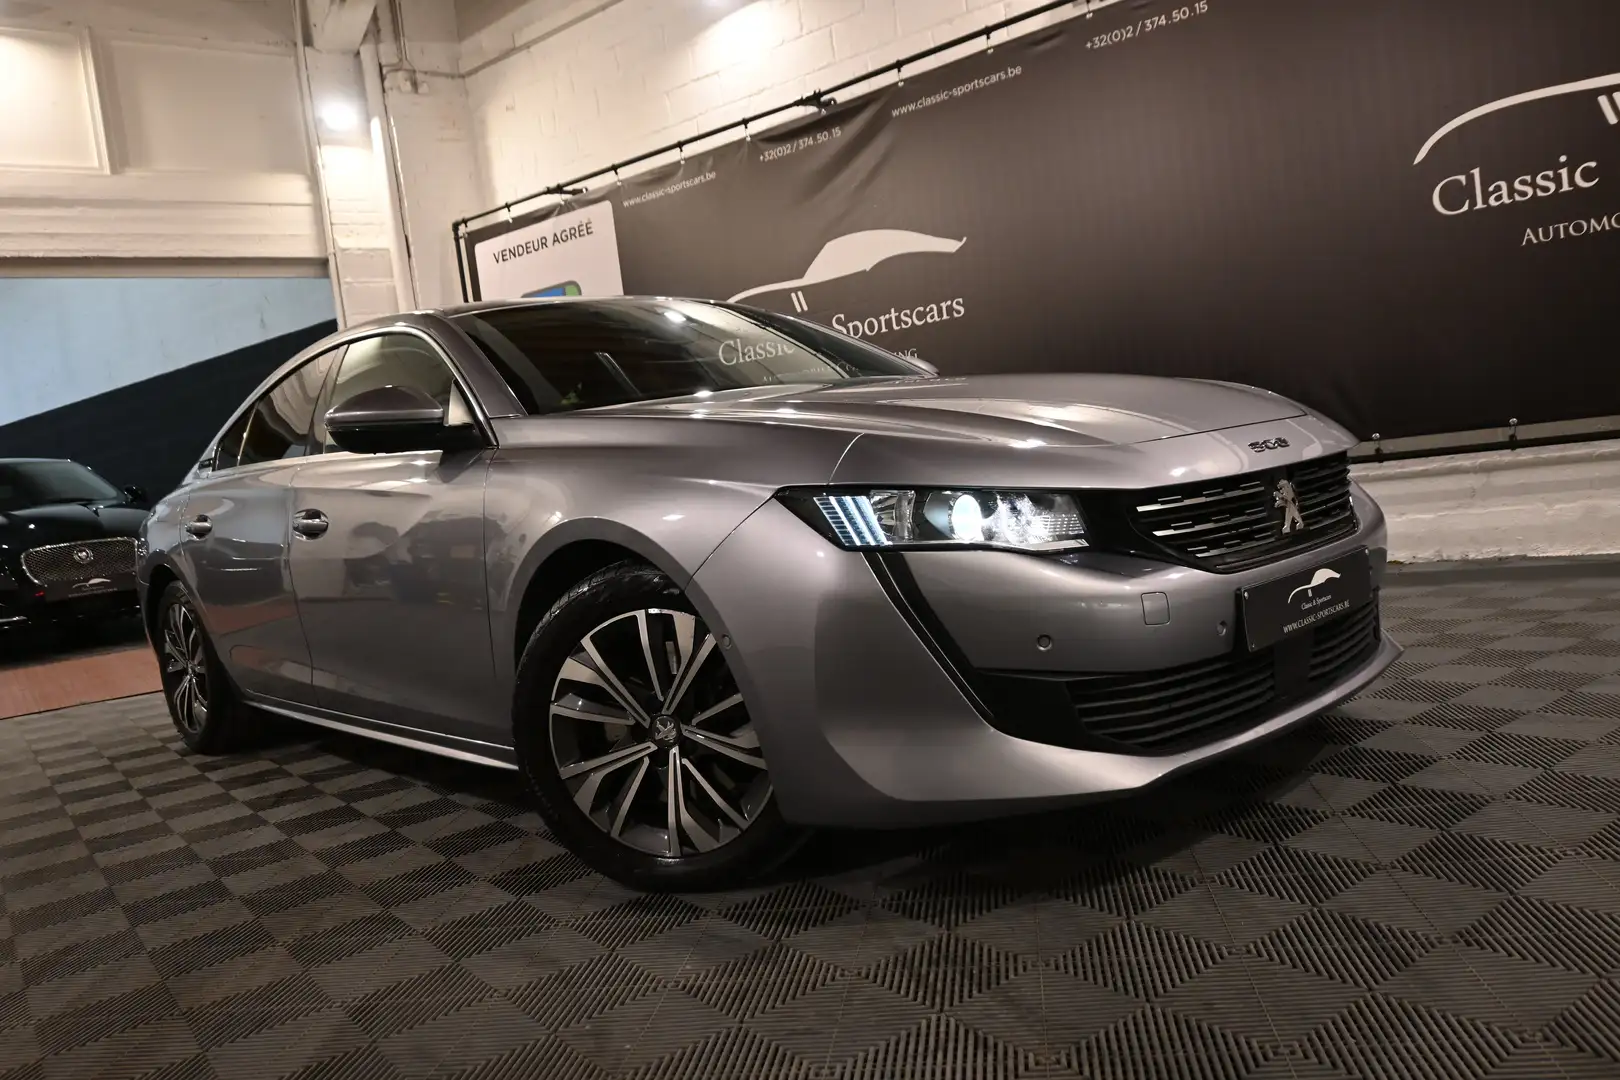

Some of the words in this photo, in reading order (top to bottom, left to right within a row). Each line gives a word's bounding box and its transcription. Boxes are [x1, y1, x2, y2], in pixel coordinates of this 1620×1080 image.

[1085, 25, 1133, 49] +32(0)2
[1144, 0, 1208, 31] 374.50.15
[891, 65, 1022, 117] www.classic-sportscars.be
[760, 143, 792, 162] +32(0)2
[799, 126, 842, 150] 374.50.15
[622, 171, 716, 208] www.classic-sportscars.be
[1432, 155, 1600, 216] Classic
[493, 236, 549, 264] VENDEUR
[552, 218, 594, 246] AGRÉÉ
[832, 297, 965, 340] Sportscars
[1283, 600, 1350, 633] WWW.CLASSIC-SPORTSCARS.BE
